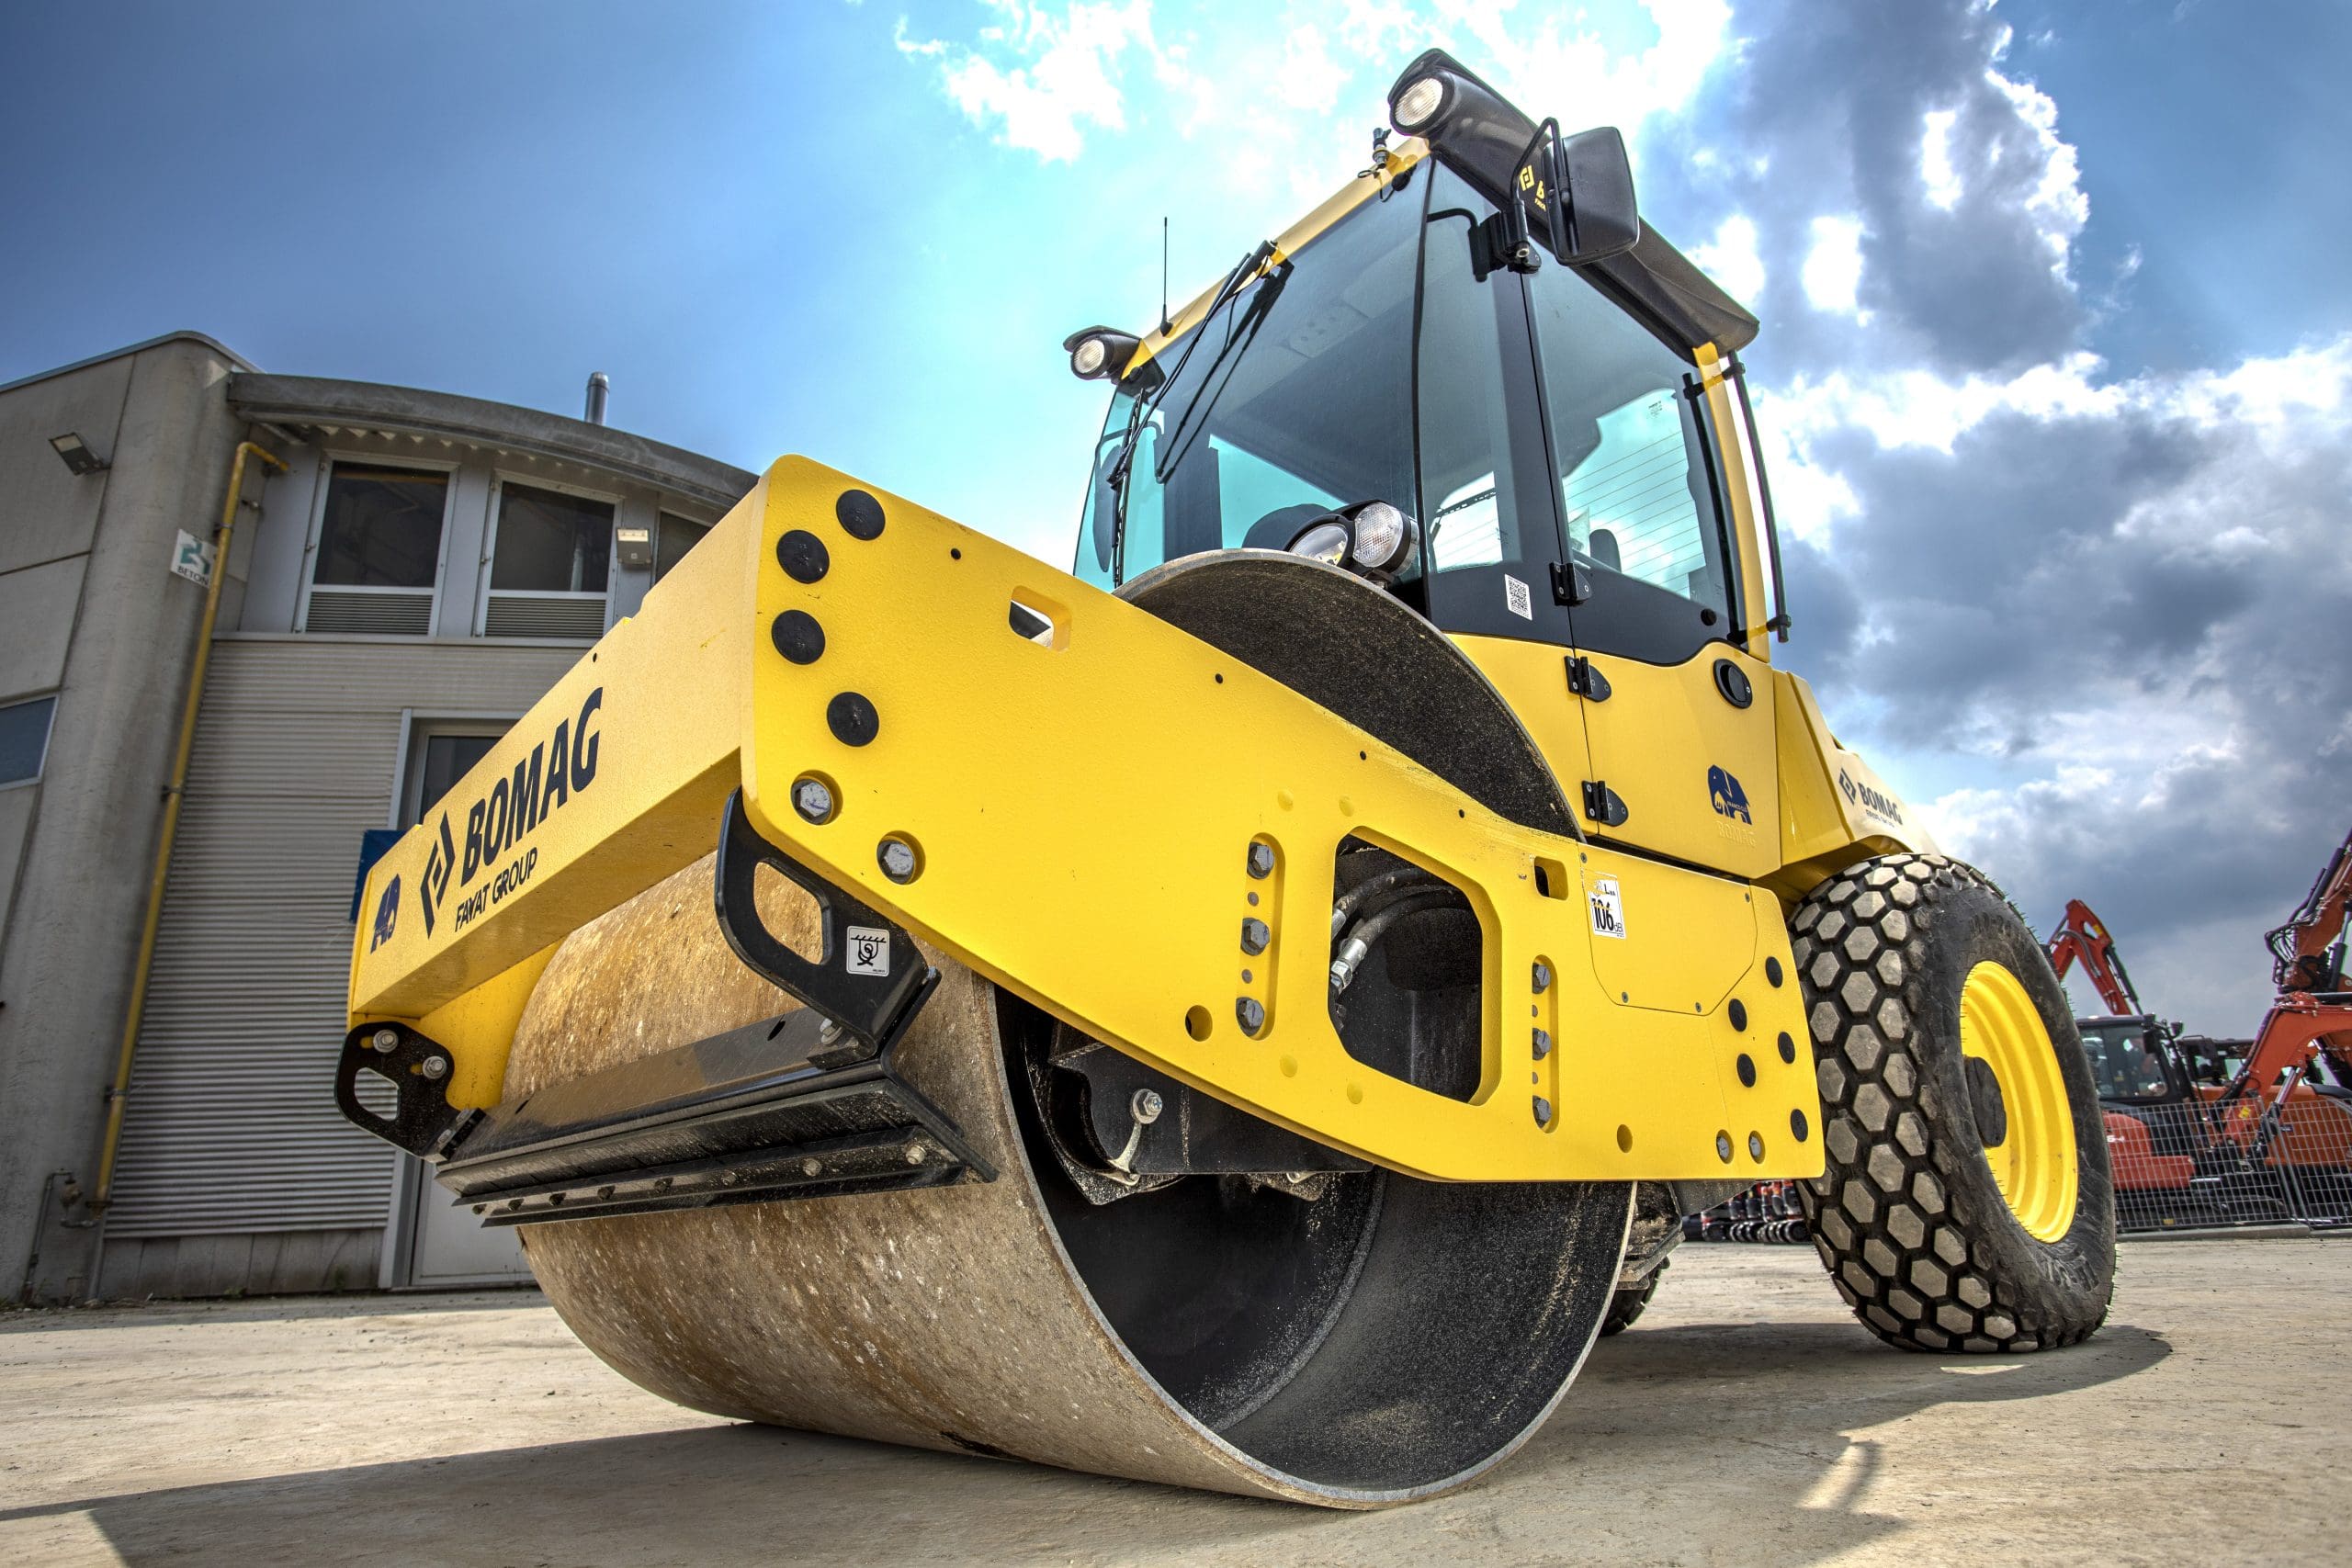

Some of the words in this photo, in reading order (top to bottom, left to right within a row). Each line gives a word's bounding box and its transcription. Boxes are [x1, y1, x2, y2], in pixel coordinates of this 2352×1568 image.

[176, 565, 209, 586] BETON
[460, 686, 604, 886] BOMAG
[1858, 782, 1903, 825] BOMAG
[455, 882, 491, 932] FAYAT
[492, 847, 537, 904] GROUP
[1591, 897, 1614, 931] 106
